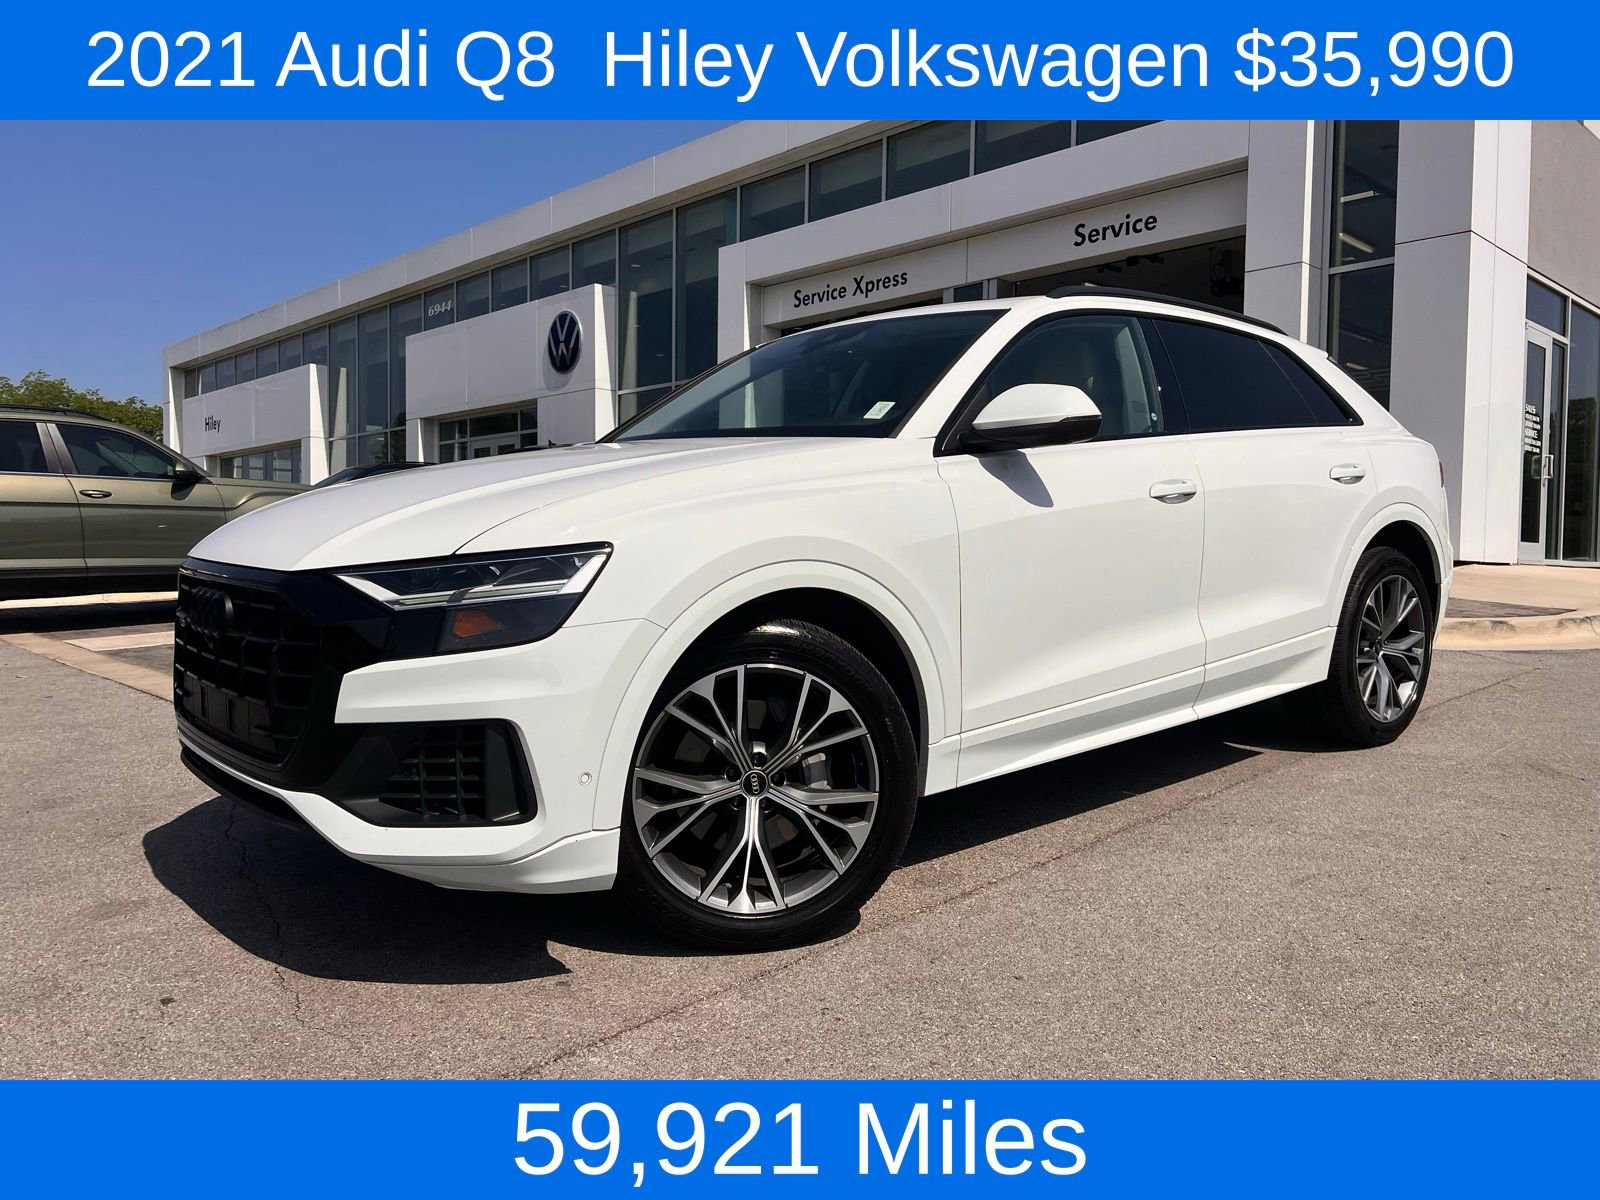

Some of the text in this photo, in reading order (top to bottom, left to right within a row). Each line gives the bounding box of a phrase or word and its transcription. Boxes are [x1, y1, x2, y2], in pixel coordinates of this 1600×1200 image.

[1073, 213, 1158, 247] Service
[793, 270, 908, 308] Service Xpress
[428, 299, 452, 317] 6944
[204, 415, 221, 433] Hiley
